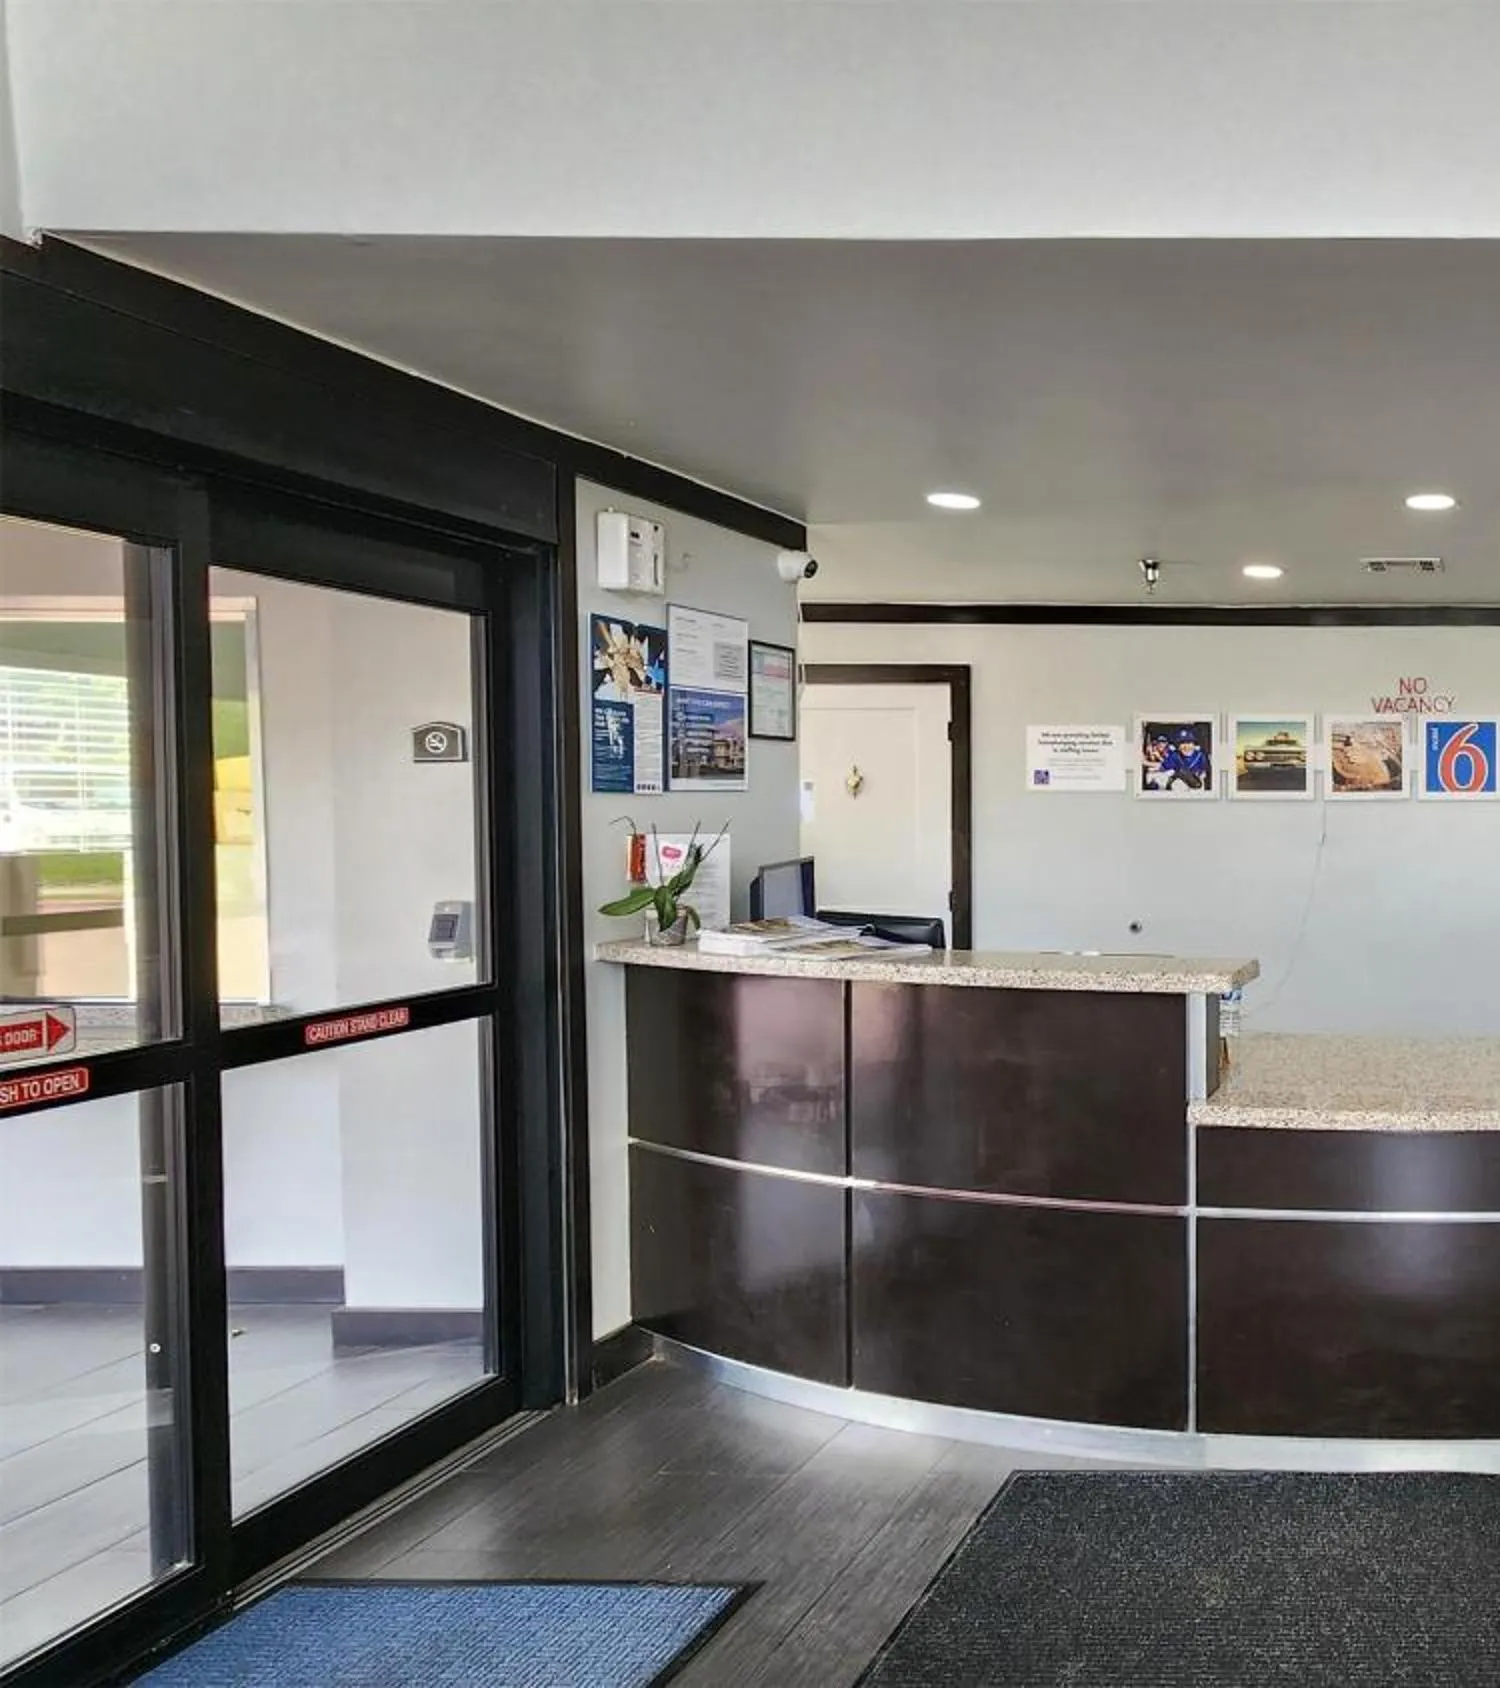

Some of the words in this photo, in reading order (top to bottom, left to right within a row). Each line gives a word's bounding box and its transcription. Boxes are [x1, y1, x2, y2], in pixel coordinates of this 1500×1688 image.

[1399, 677, 1428, 694] NO
[1371, 695, 1456, 714] VACANCY
[1438, 723, 1489, 792] 6
[4, 1027, 37, 1046] DOOR
[309, 1019, 349, 1041] CAUTION
[0, 1084, 19, 1103] SH
[20, 1080, 41, 1099] TO
[42, 1073, 80, 1095] OPEN
